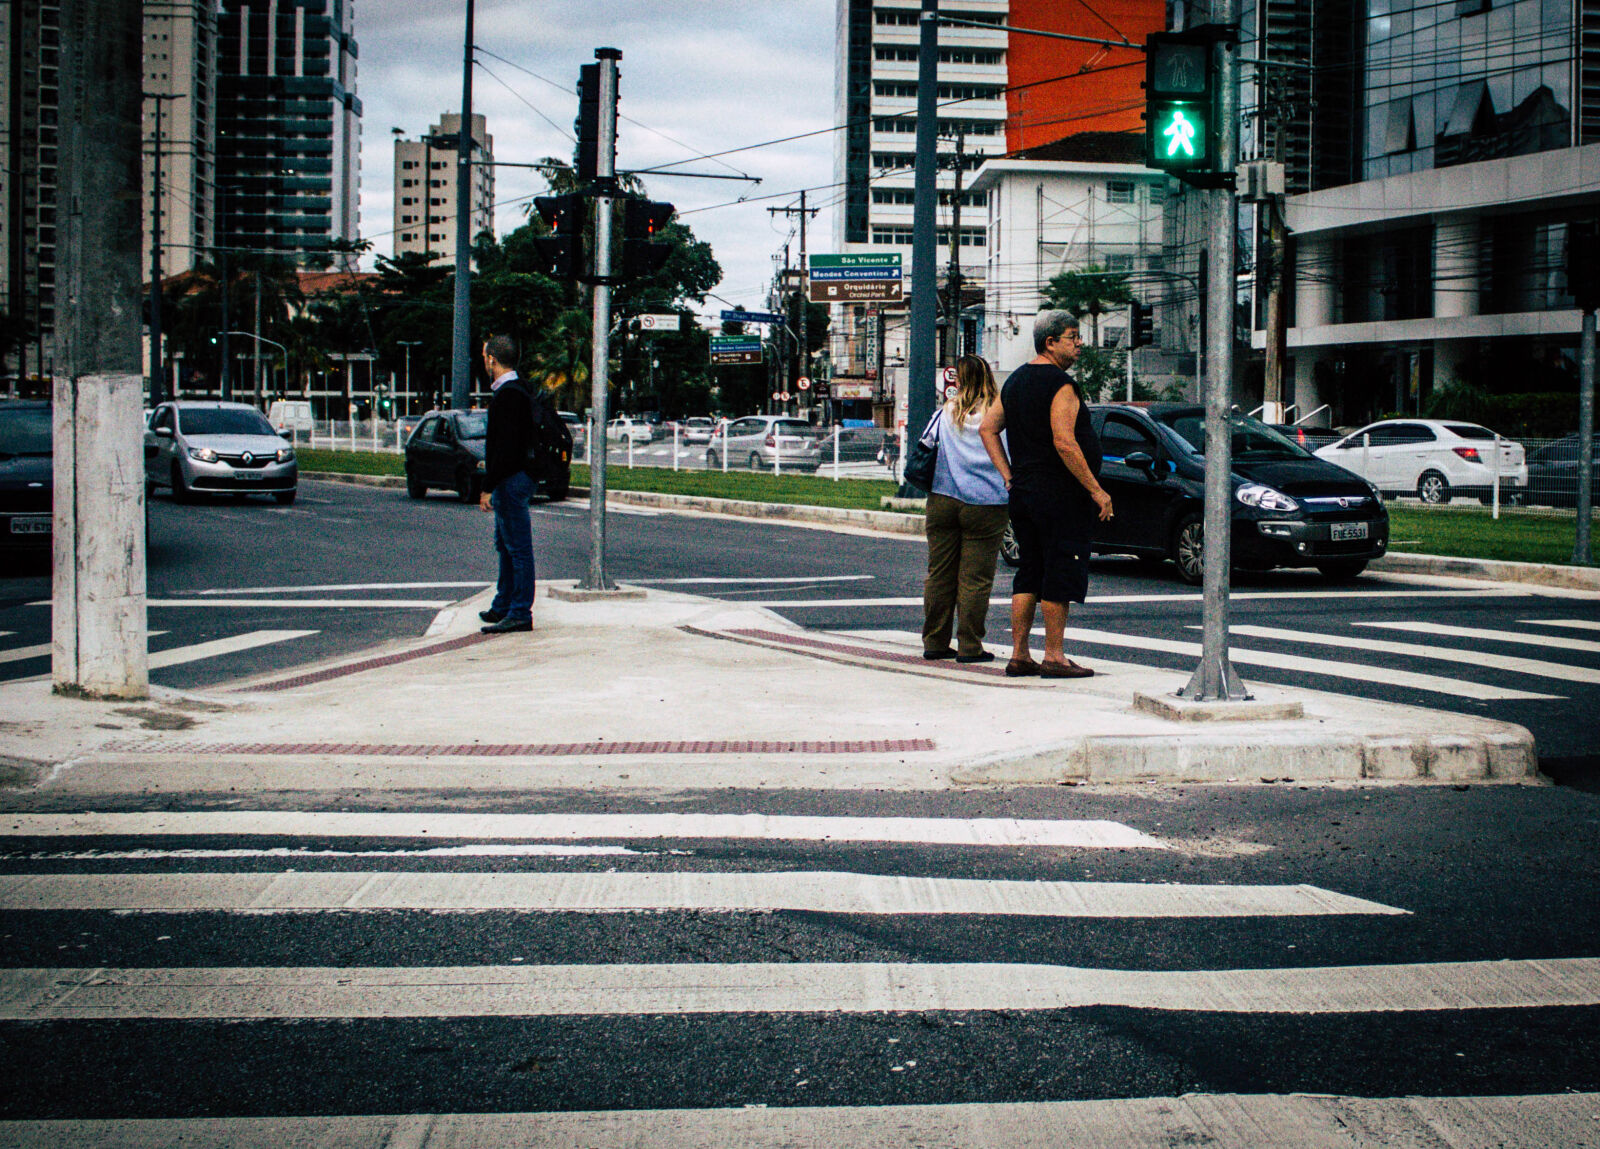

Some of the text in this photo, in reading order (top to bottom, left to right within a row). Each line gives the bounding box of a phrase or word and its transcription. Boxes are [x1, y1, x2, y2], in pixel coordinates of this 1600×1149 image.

[841, 256, 856, 264] São
[844, 283, 886, 291] Orquidário
[947, 388, 958, 397] 50
